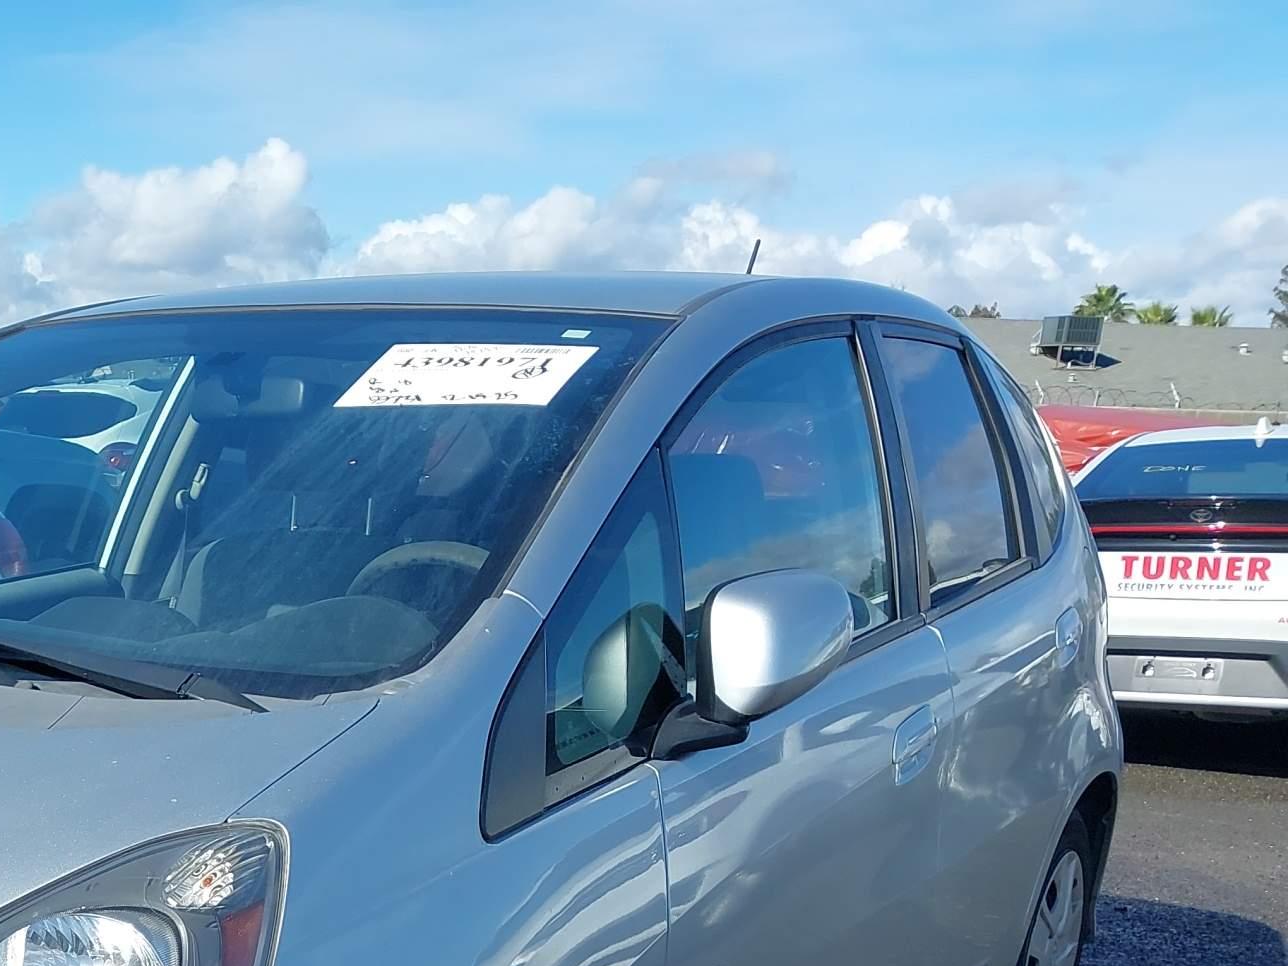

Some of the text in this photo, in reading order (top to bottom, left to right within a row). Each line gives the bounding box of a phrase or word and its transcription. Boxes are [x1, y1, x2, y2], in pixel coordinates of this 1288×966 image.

[394, 356, 553, 369] 43981971
[1121, 555, 1272, 582] TURNER
[1117, 582, 1174, 592] SECURITY
